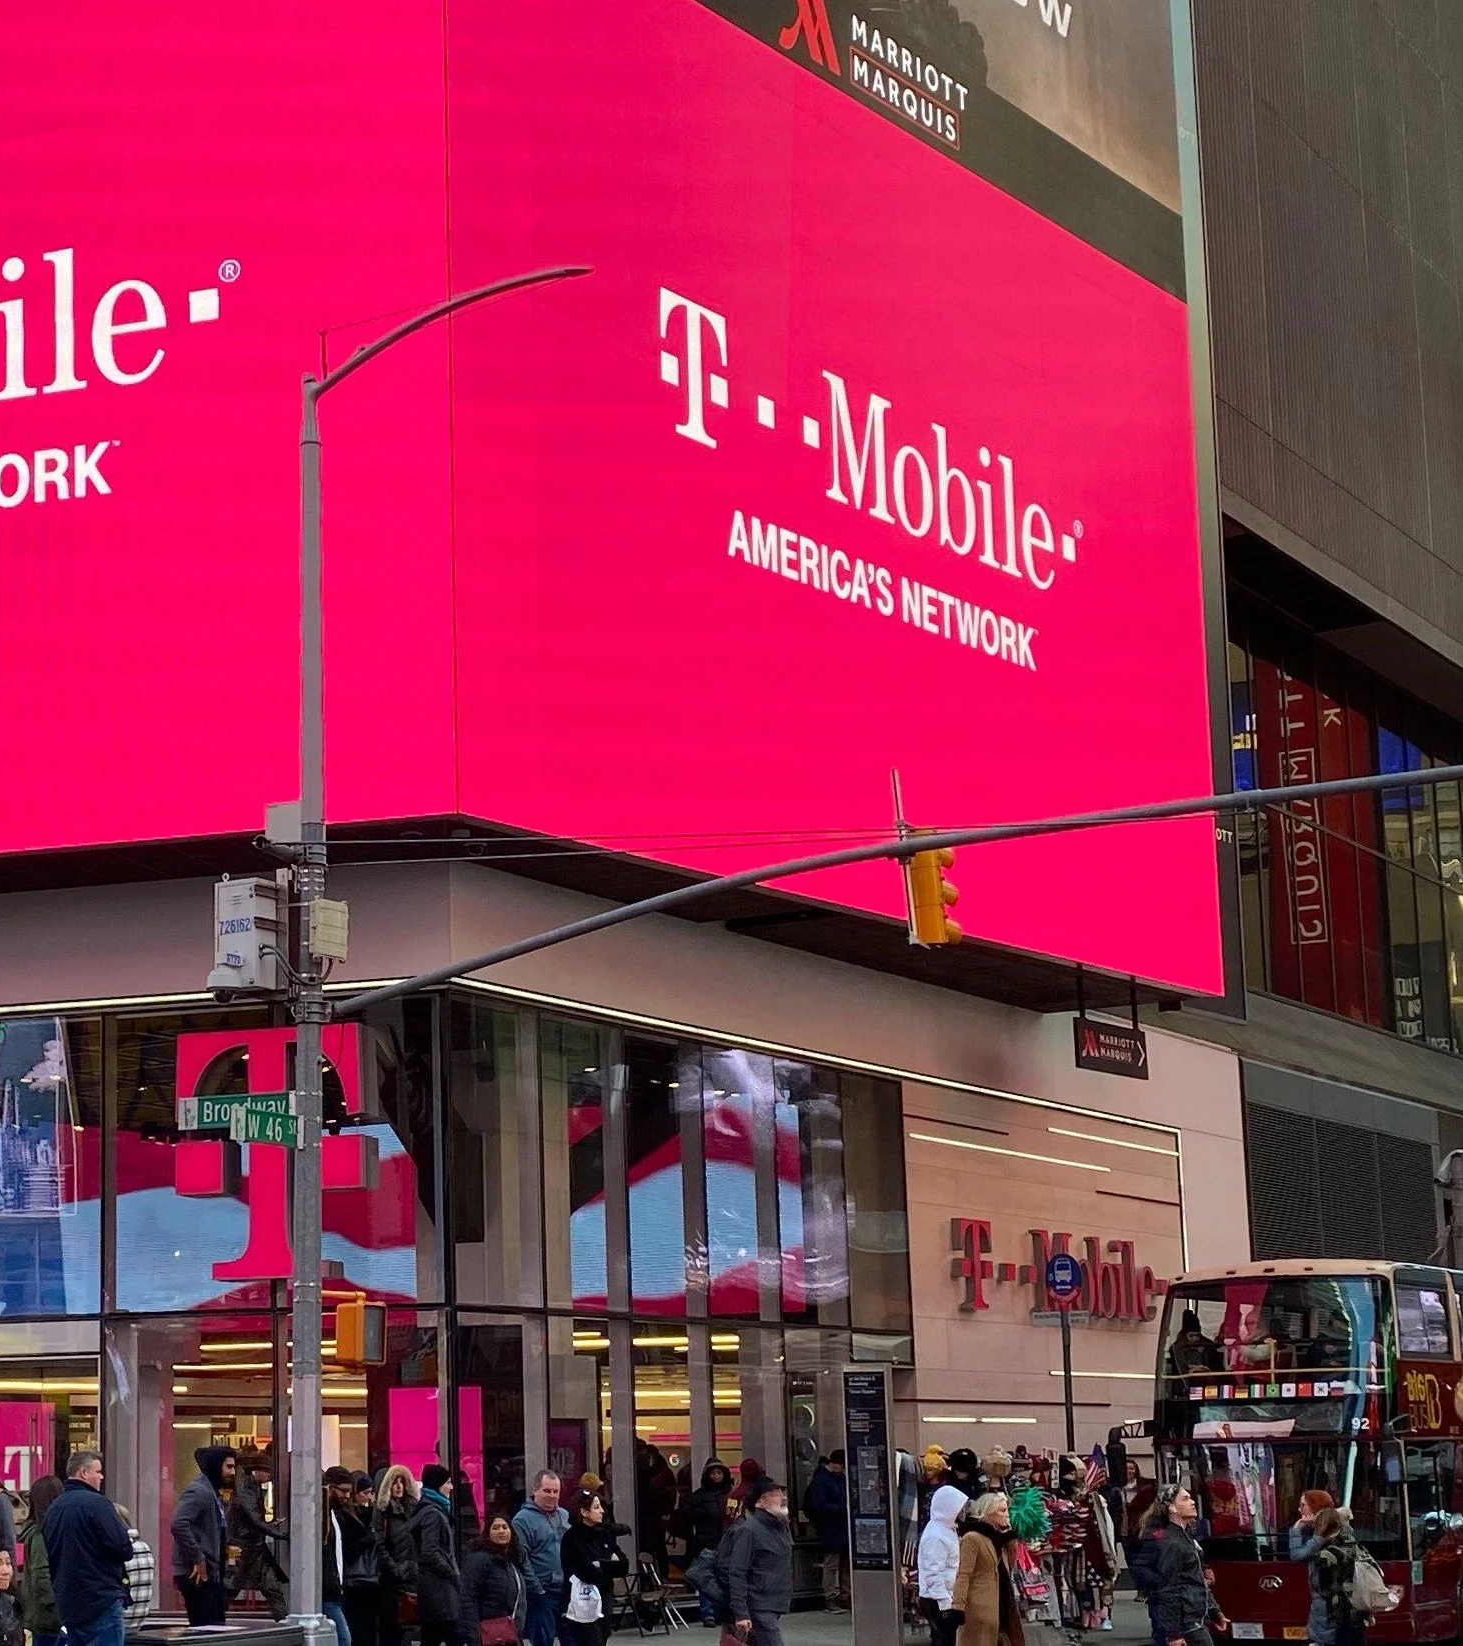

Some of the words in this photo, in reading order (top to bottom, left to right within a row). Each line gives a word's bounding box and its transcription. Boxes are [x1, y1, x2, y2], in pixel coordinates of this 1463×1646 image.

[852, 14, 968, 111] MARRIOTT
[853, 54, 957, 142] MARQUIS
[728, 509, 894, 617] AMERICA'S
[901, 576, 1037, 672] NETWORK
[248, 1113, 260, 1139] W
[266, 1117, 283, 1142] 46
[1351, 1417, 1370, 1430] 92
